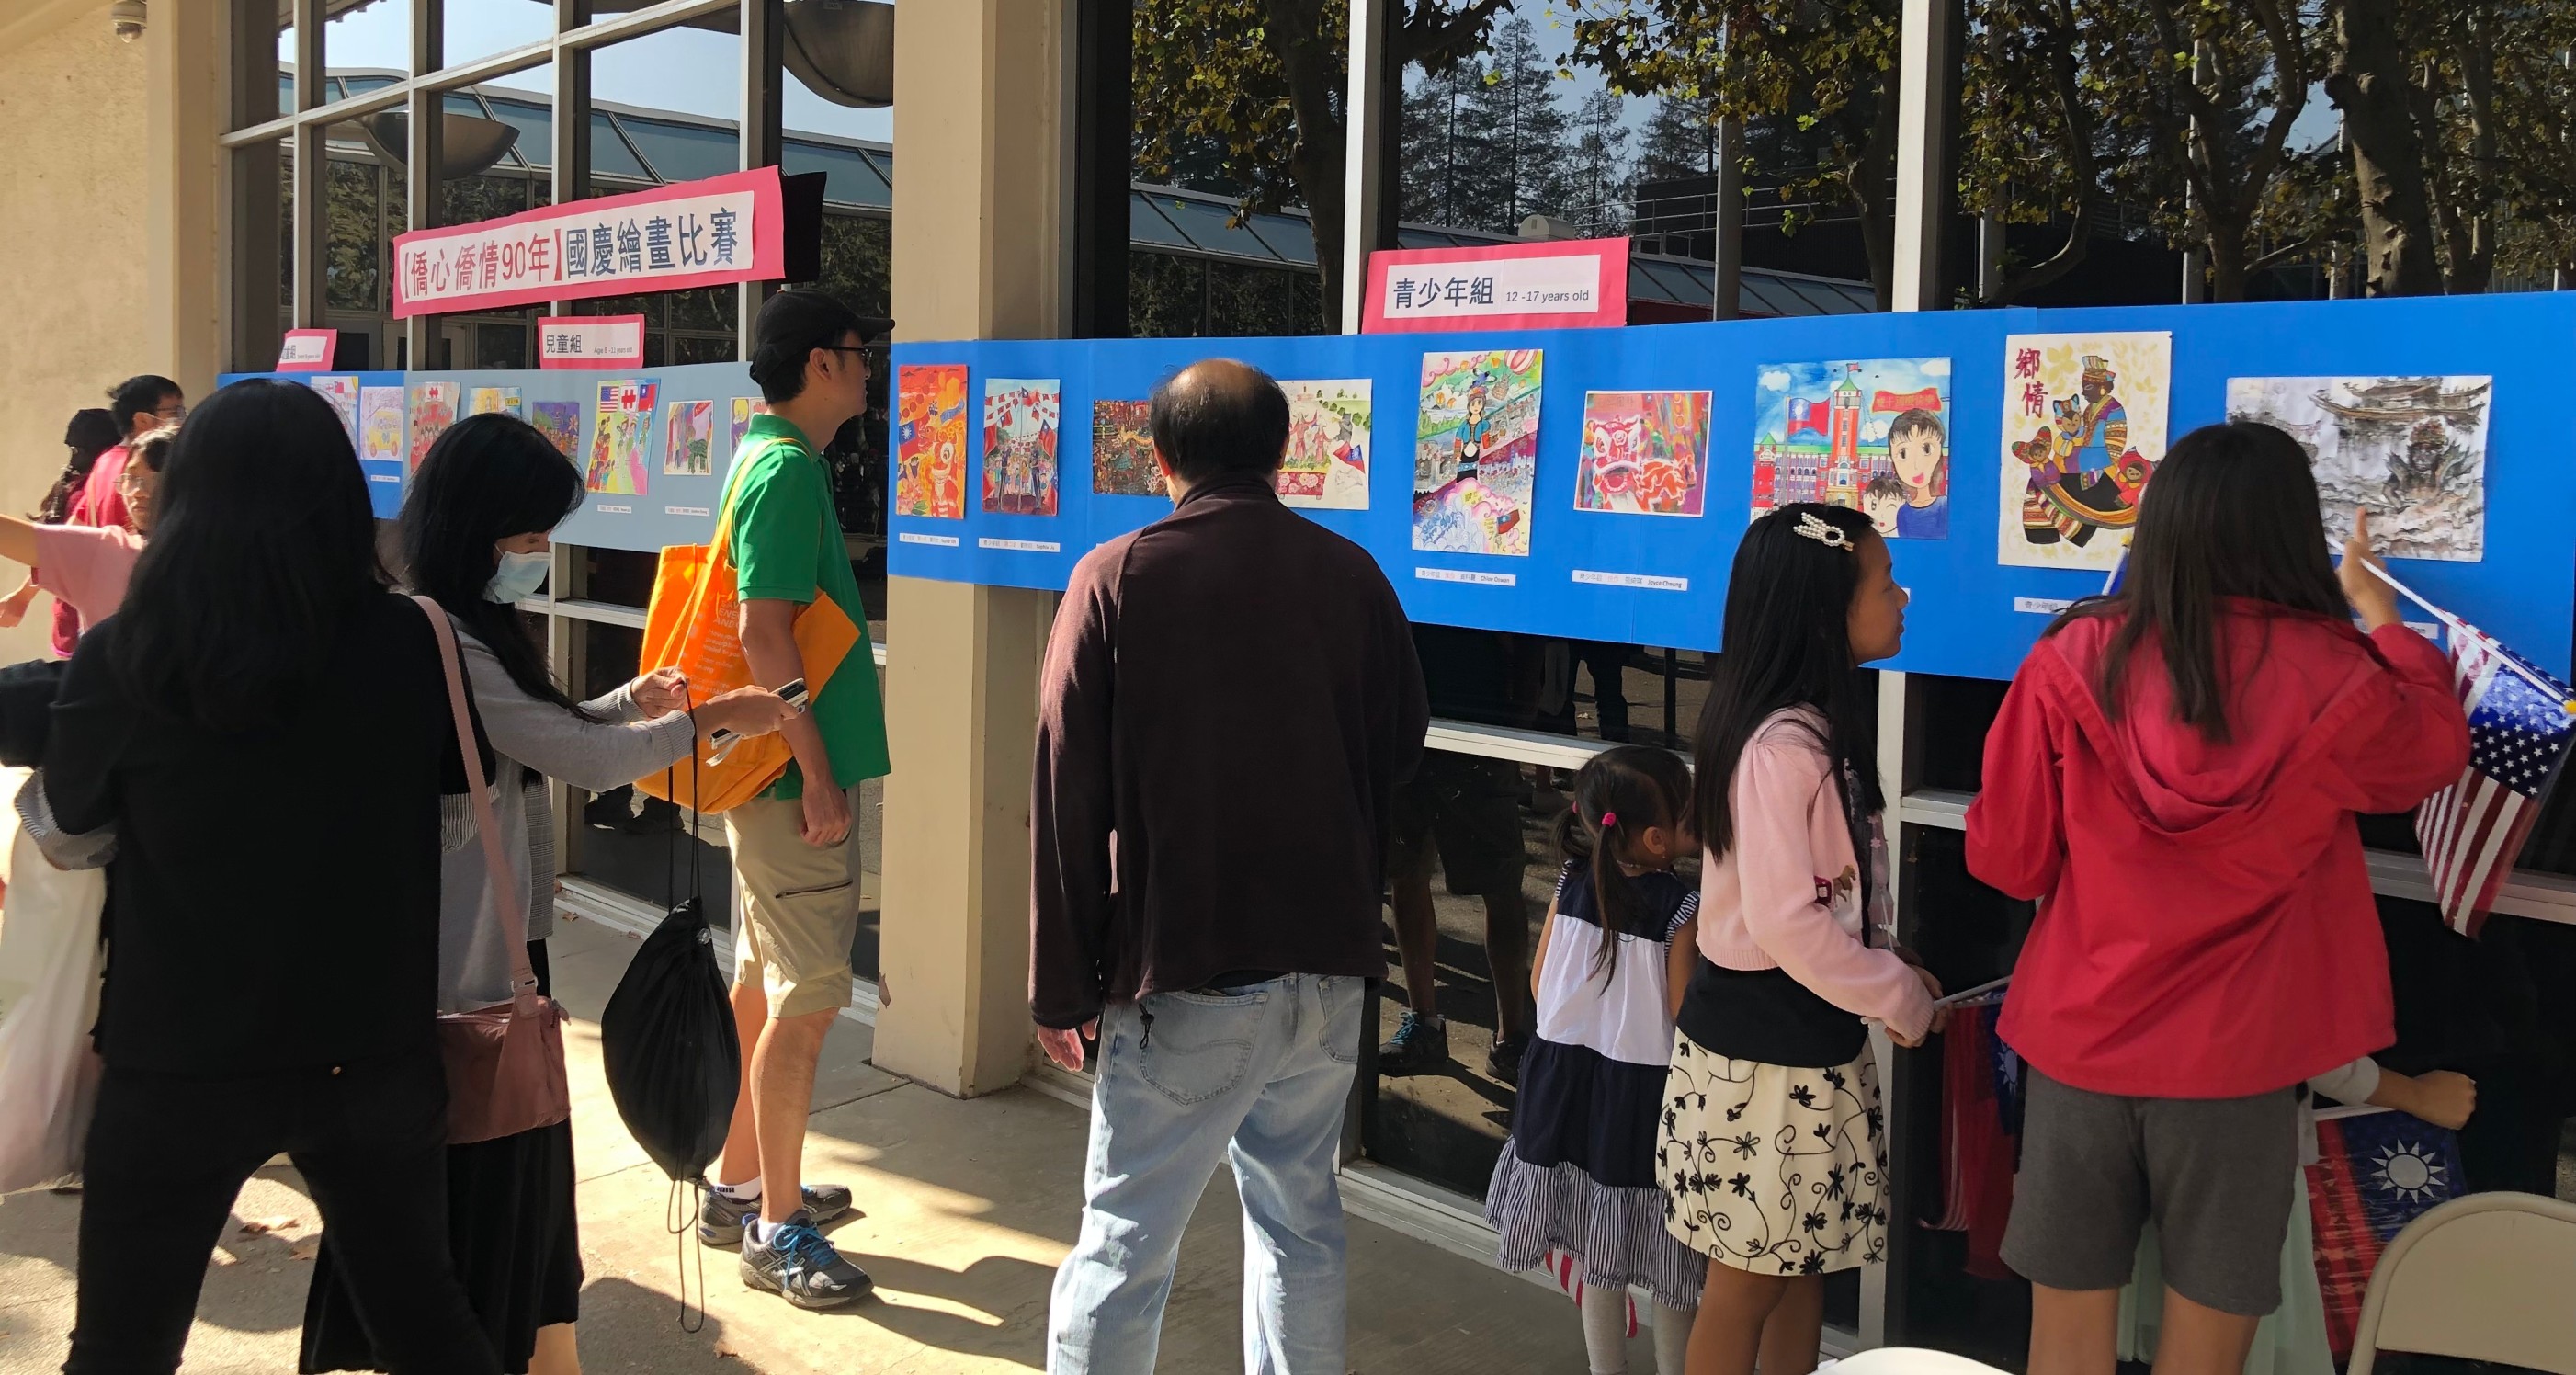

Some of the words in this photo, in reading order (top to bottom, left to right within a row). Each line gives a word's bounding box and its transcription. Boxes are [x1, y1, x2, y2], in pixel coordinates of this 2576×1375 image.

[1393, 277, 1494, 310] 青少年組
[1505, 291, 1518, 302] 12
[1522, 290, 1540, 301] -17
[1542, 291, 1570, 303] years
[1572, 290, 1590, 301] old
[546, 334, 583, 354] 兒童組
[281, 345, 296, 359] 童組
[2014, 348, 2048, 419] 鄉情
[1662, 580, 1682, 588] Cheung
[721, 600, 739, 609] SAV
[713, 618, 735, 628] AND
